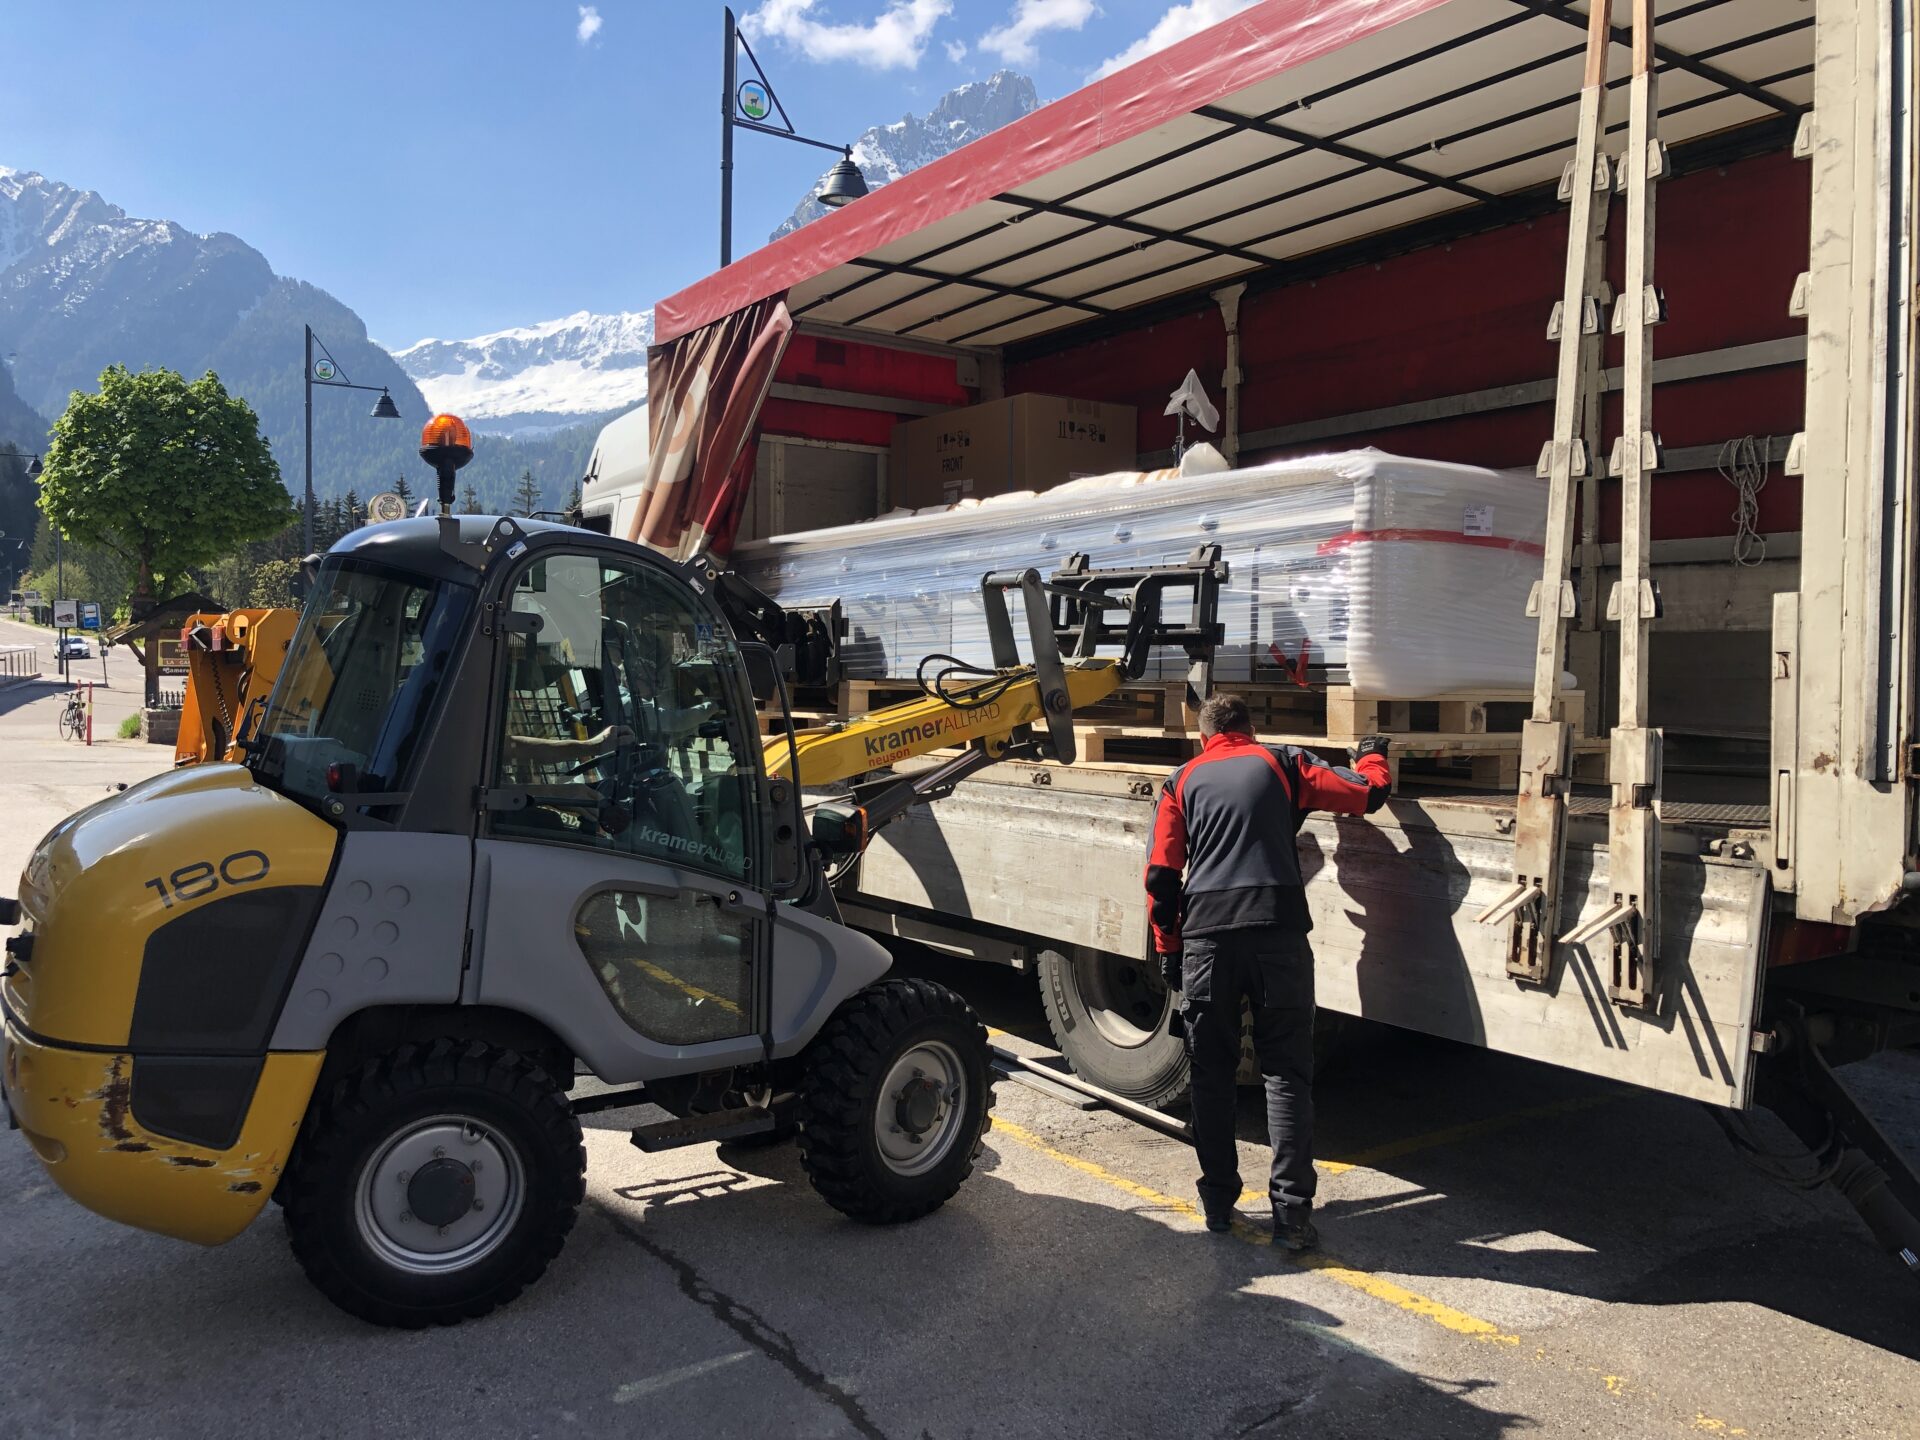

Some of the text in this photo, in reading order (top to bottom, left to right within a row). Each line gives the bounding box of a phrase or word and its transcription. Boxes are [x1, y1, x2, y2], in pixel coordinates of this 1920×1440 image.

[943, 456, 963, 473] FRONT
[868, 747, 911, 767] neuson
[145, 850, 270, 908] 180
